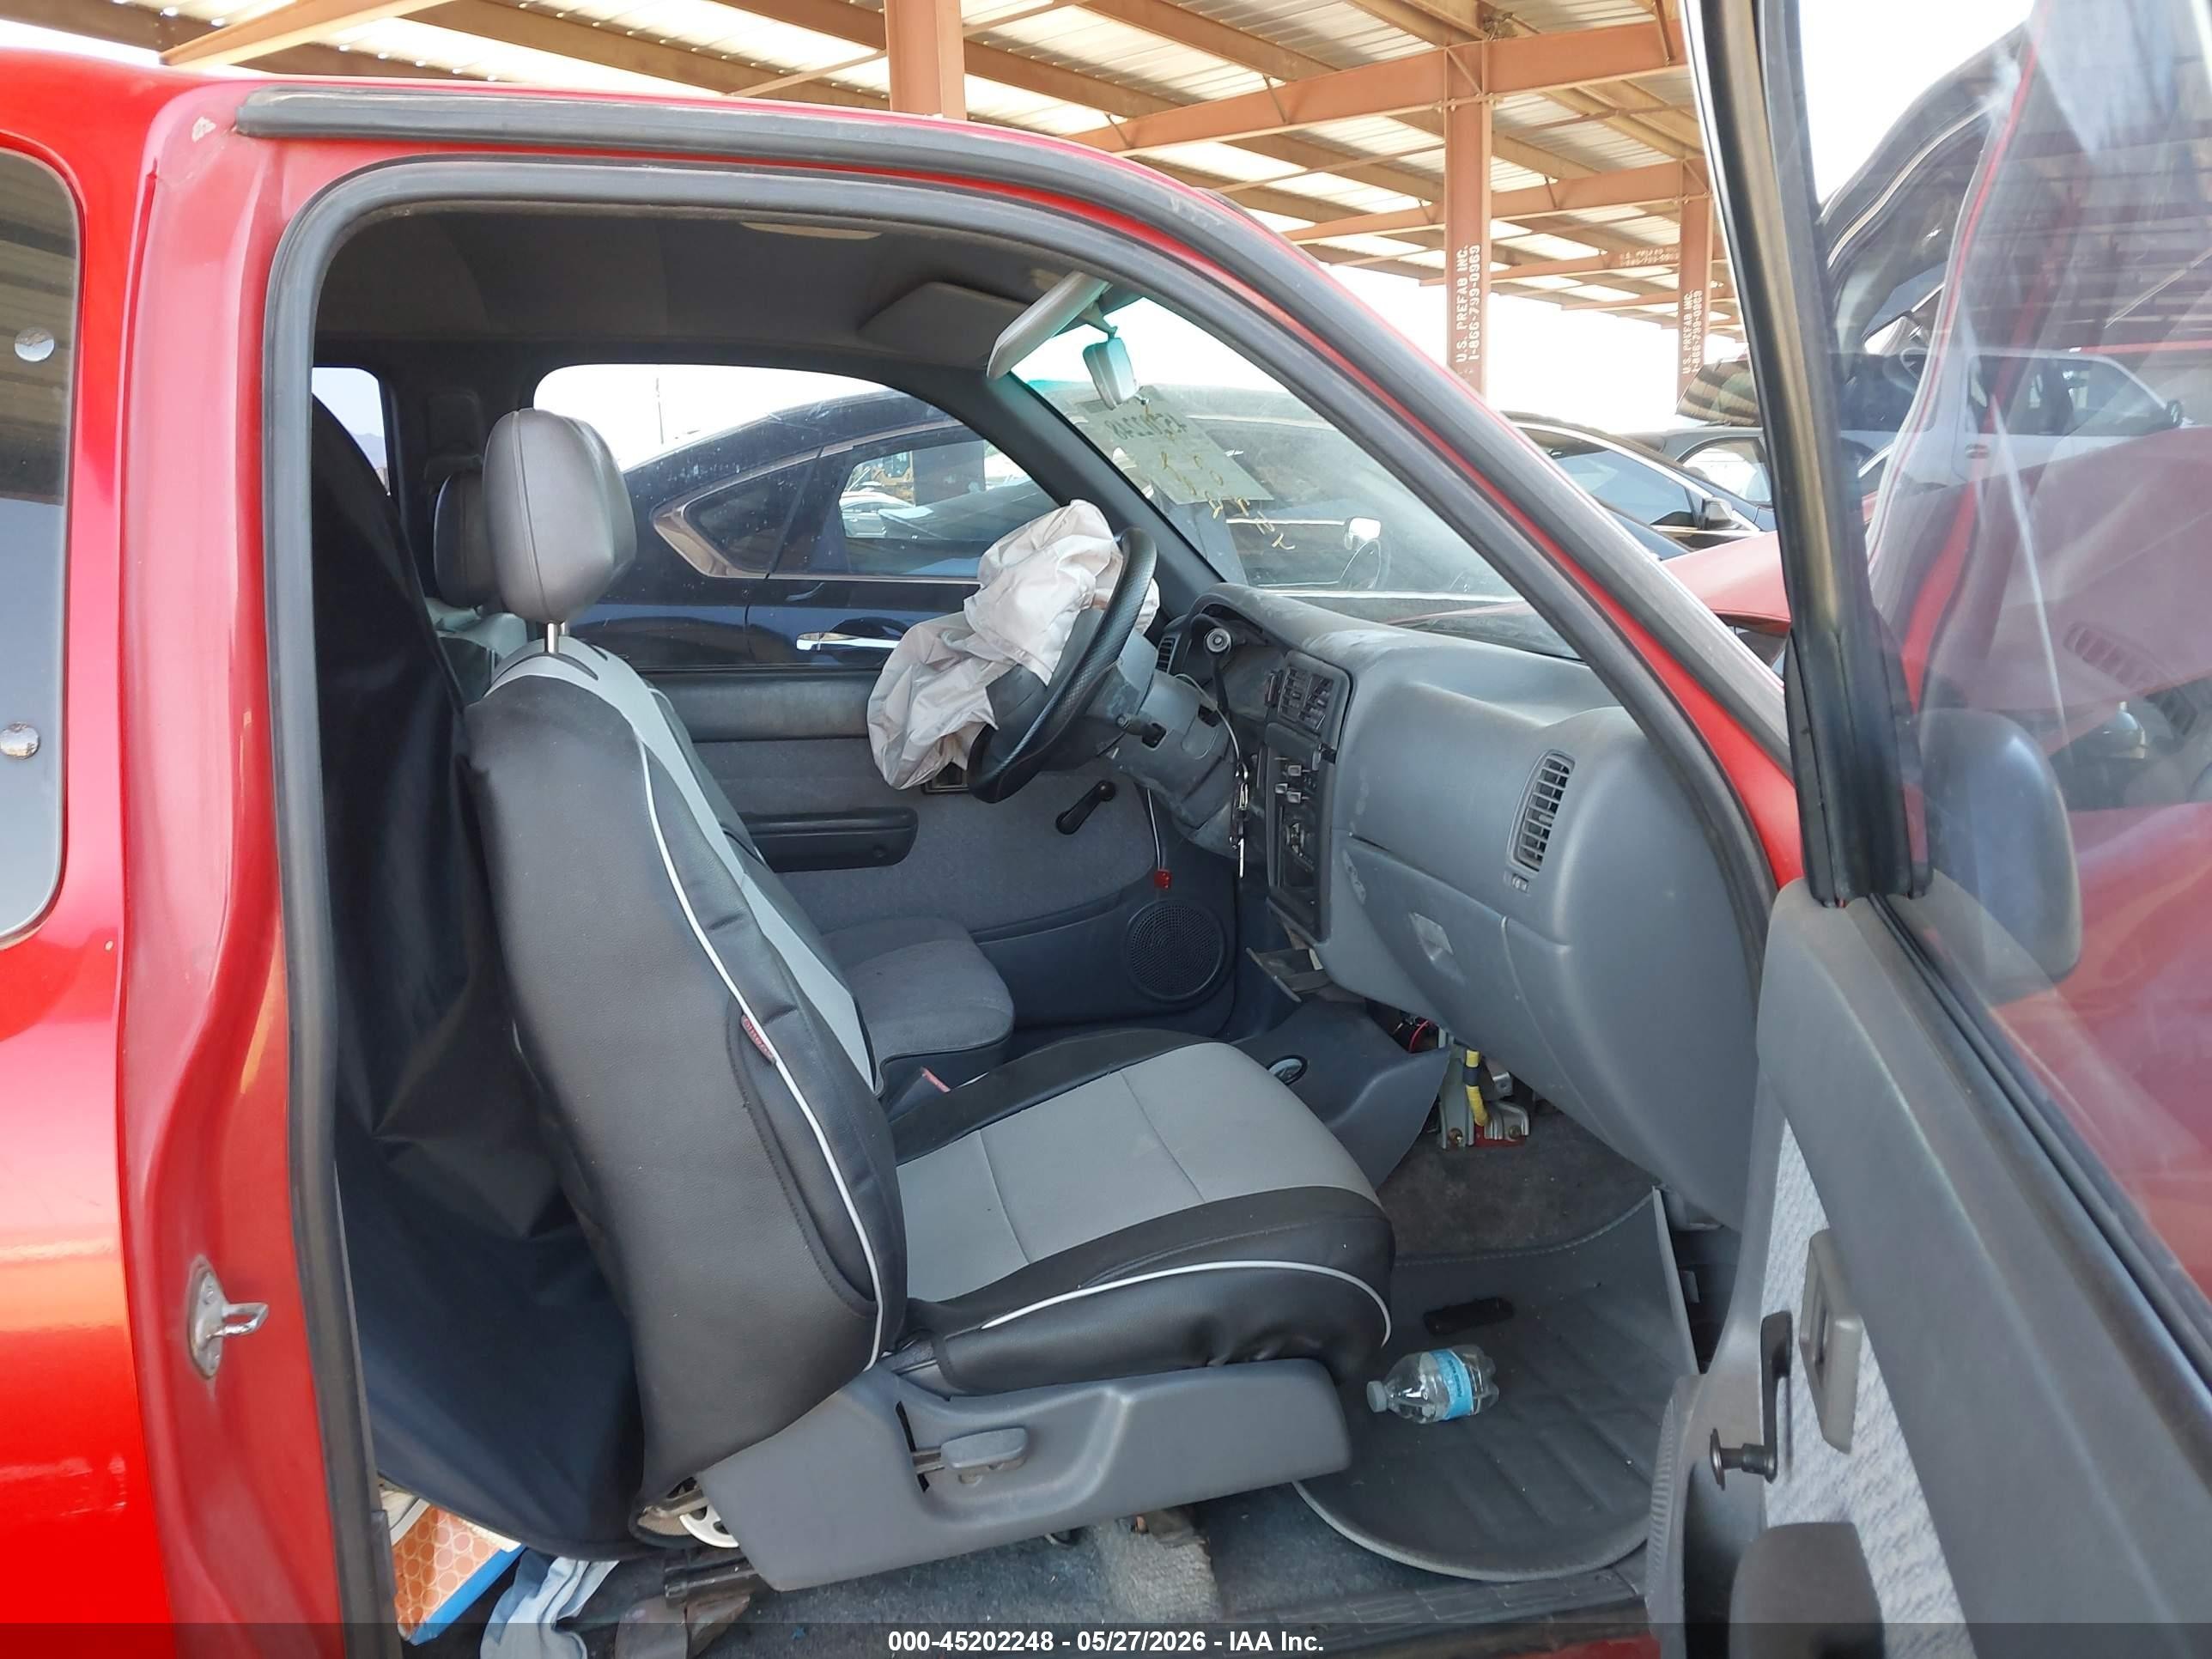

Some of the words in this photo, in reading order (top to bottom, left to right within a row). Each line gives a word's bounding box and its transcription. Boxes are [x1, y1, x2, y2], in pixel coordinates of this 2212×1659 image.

[1456, 245, 1468, 271] INC.
[1456, 277, 1468, 331] PREFAB
[1468, 245, 1480, 361] 1-866-799-0969
[1456, 337, 1468, 363] U.S.
